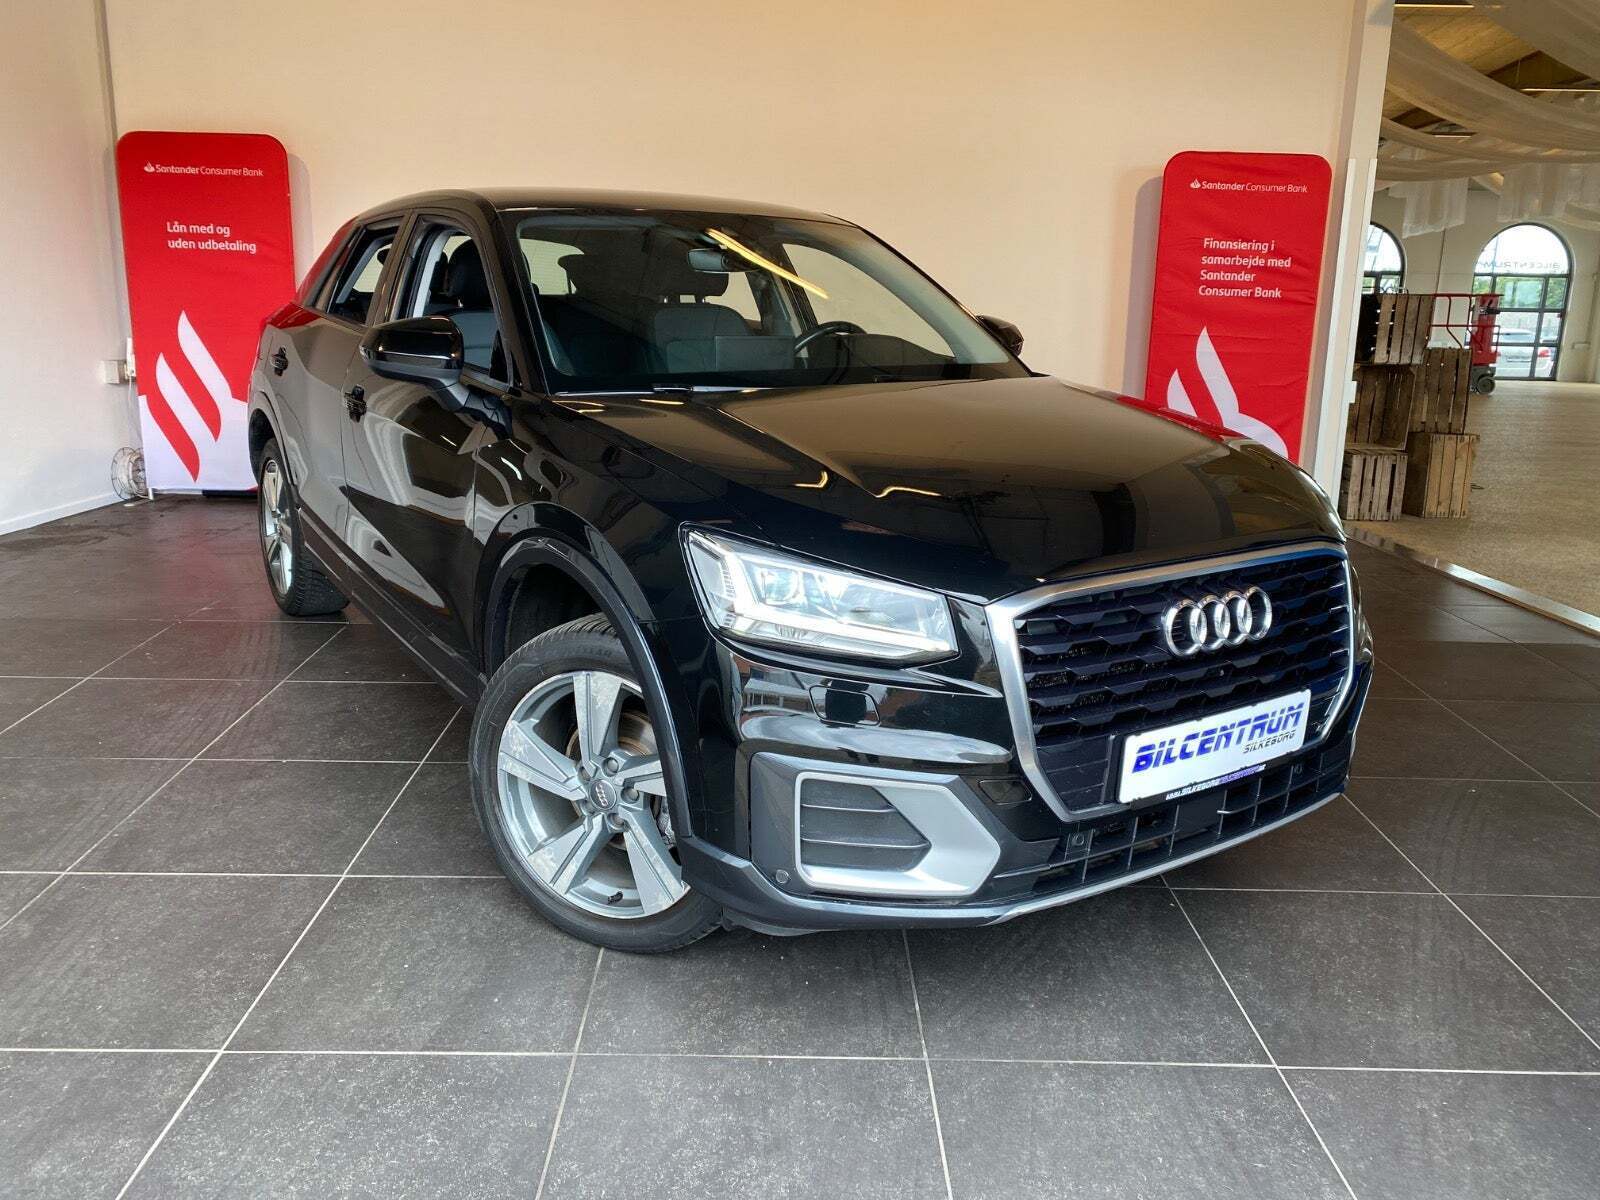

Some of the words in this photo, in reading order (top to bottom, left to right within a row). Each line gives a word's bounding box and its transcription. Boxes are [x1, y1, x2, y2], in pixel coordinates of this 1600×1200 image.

[155, 164, 200, 174] Santander
[200, 166, 241, 176] Consumer
[242, 168, 263, 176] Bank
[1201, 181, 1246, 190] Santander
[1246, 182, 1287, 192] Consumer
[1287, 184, 1308, 193] Bank
[166, 221, 187, 233] Lån
[189, 223, 214, 234] med
[216, 226, 231, 238] og
[167, 238, 196, 249] uden
[198, 239, 257, 254] udbetaling
[1203, 238, 1269, 253] Finansiering
[1201, 255, 1265, 268] samarbejde
[1267, 257, 1292, 268] med
[1200, 269, 1256, 281] Santander
[1198, 285, 1252, 297] Consumer
[1254, 287, 1282, 298] Bank
[1131, 702, 1304, 774] BILCENTRUM
[1242, 729, 1296, 754] SILKEBORG
